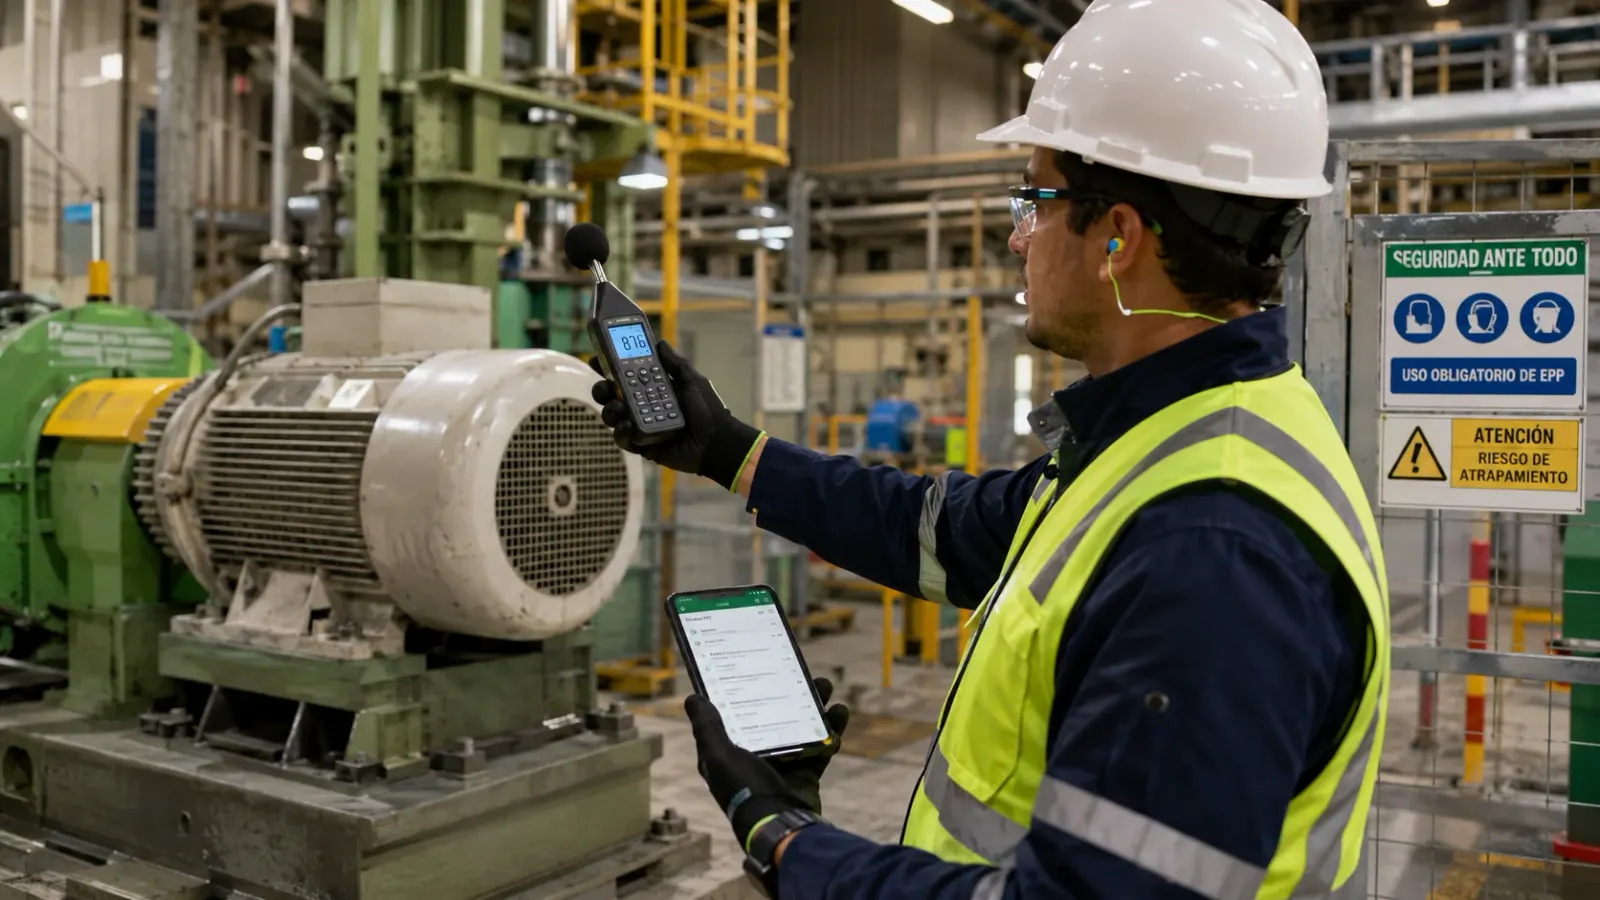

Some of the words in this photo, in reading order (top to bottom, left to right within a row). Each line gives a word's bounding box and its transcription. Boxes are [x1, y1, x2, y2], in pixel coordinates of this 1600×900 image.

[1393, 249, 1480, 268] SEGURIDAD
[1483, 248, 1526, 268] ANTE
[1531, 247, 1578, 267] TODO
[1402, 368, 1428, 382] USO
[1431, 368, 1516, 382] OBLIGATORIO
[1519, 368, 1536, 382] DE
[1540, 368, 1565, 382] EPP
[1473, 424, 1554, 444] ATENCIÓN
[1478, 452, 1528, 466] RIESGO
[1532, 453, 1550, 466] DE
[1459, 469, 1568, 484] ATRAPAMIENTO
